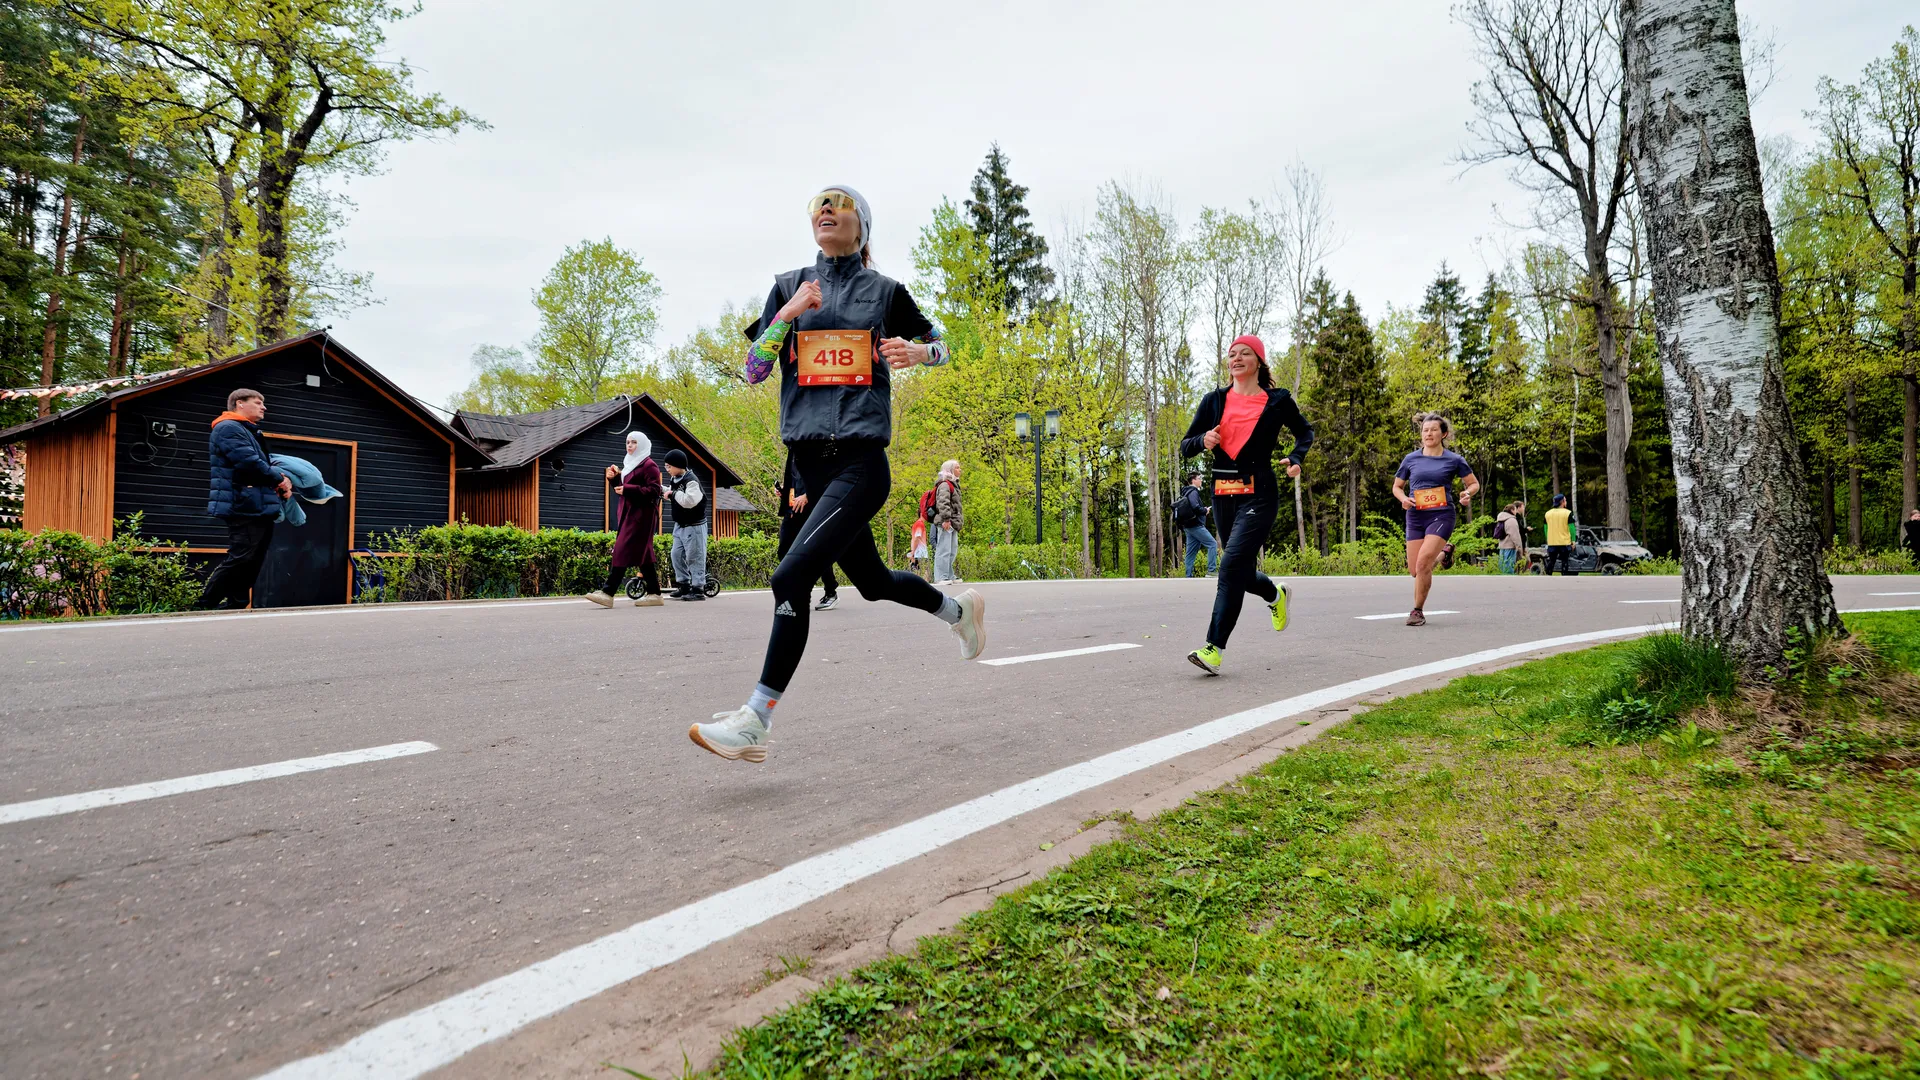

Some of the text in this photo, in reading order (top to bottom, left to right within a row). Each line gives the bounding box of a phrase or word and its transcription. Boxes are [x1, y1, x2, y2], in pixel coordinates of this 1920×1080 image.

[813, 349, 854, 366] 418
[1424, 494, 1437, 502] 36
[776, 608, 796, 616] adidas
